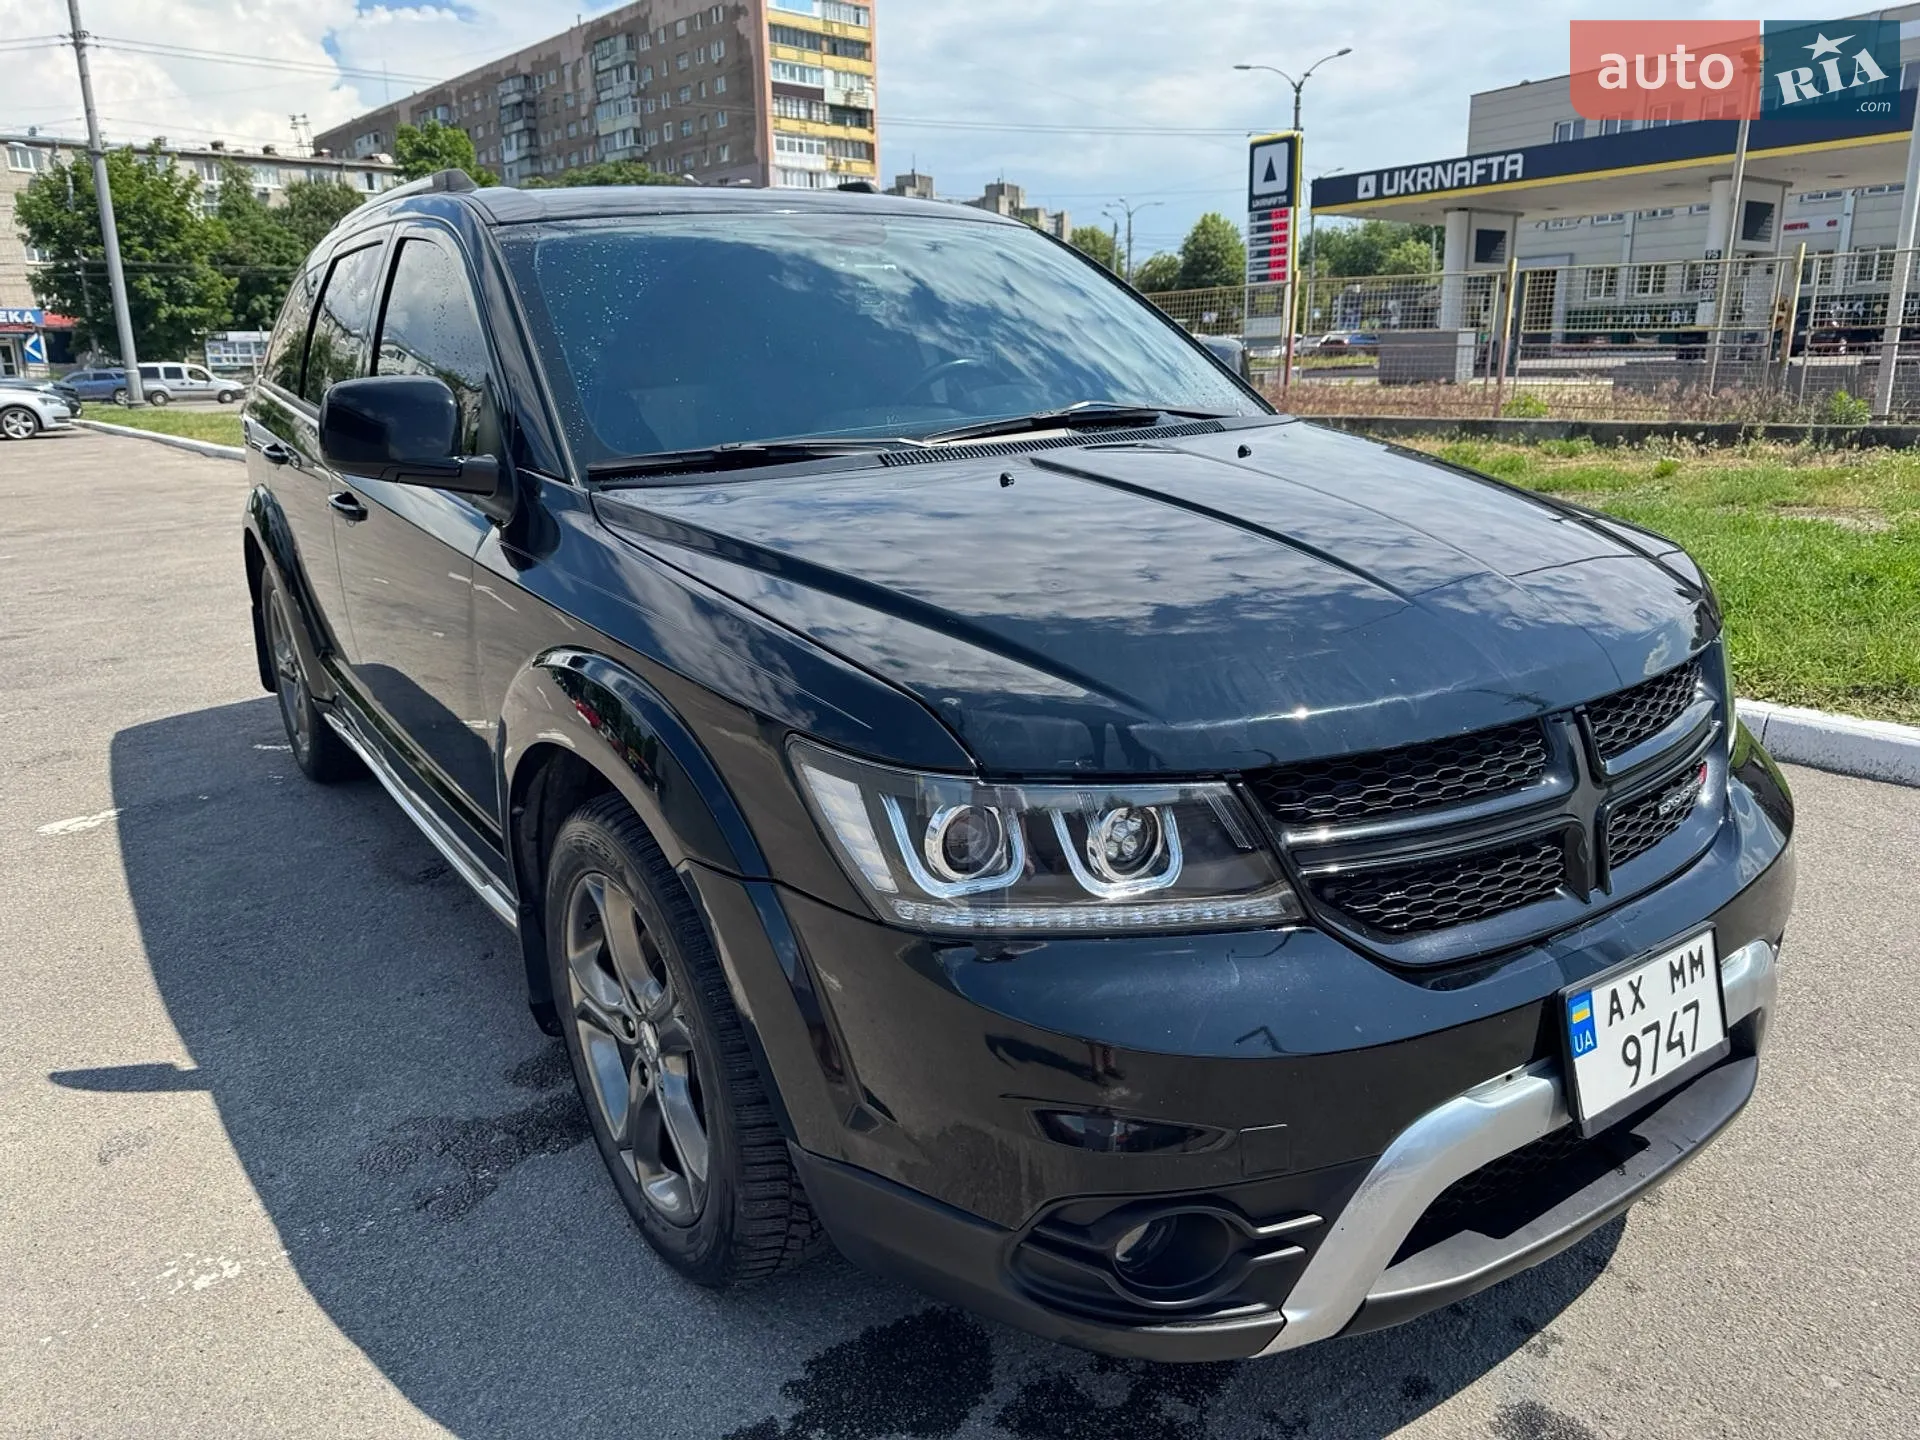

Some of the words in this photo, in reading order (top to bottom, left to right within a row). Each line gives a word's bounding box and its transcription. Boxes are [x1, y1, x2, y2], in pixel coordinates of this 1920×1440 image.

[1382, 153, 1524, 196] UKRNAFTA
[1607, 974, 1646, 1028] AX
[1669, 945, 1705, 994] MM
[1573, 1029, 1594, 1053] UA
[1621, 998, 1700, 1089] 9747
